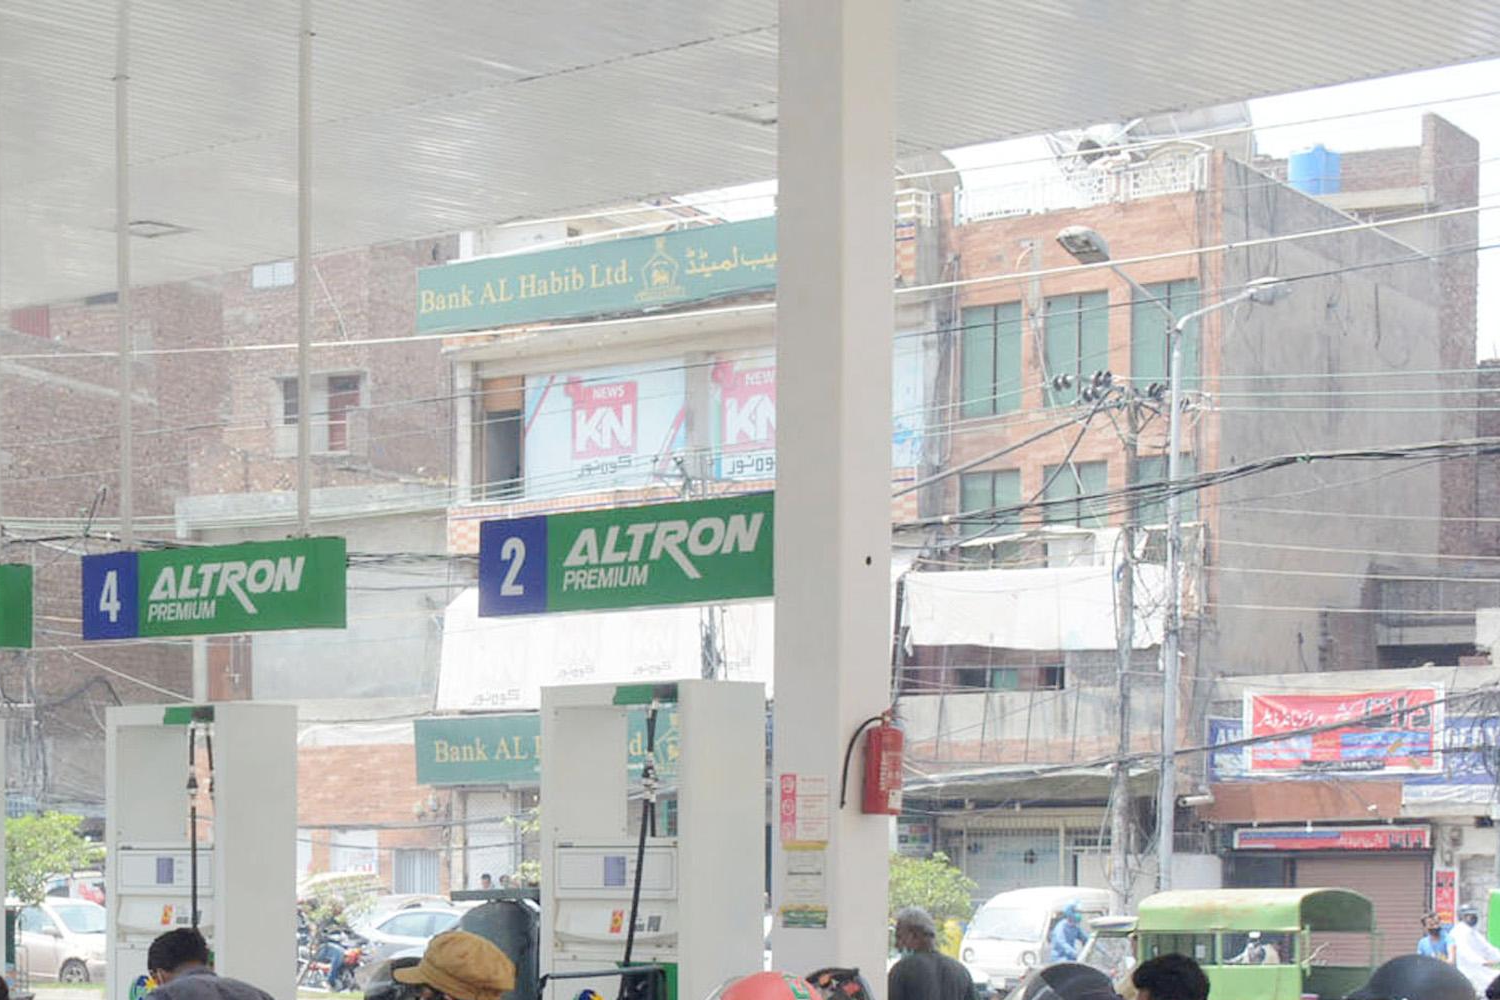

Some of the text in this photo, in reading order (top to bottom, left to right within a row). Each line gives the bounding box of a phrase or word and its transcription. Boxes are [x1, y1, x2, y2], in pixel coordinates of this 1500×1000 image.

[420, 260, 634, 314] Bank AL Habib Ltd.
[593, 385, 625, 399] NEWS
[745, 370, 775, 386] NEW
[576, 404, 632, 452] KN
[500, 512, 764, 597] 2 ALTRON
[100, 556, 305, 623] 4 ALTRON
[563, 564, 648, 592] PREMIUM
[148, 600, 216, 622] PREMIUM
[435, 736, 488, 762] Bank
[495, 735, 528, 760] AL
